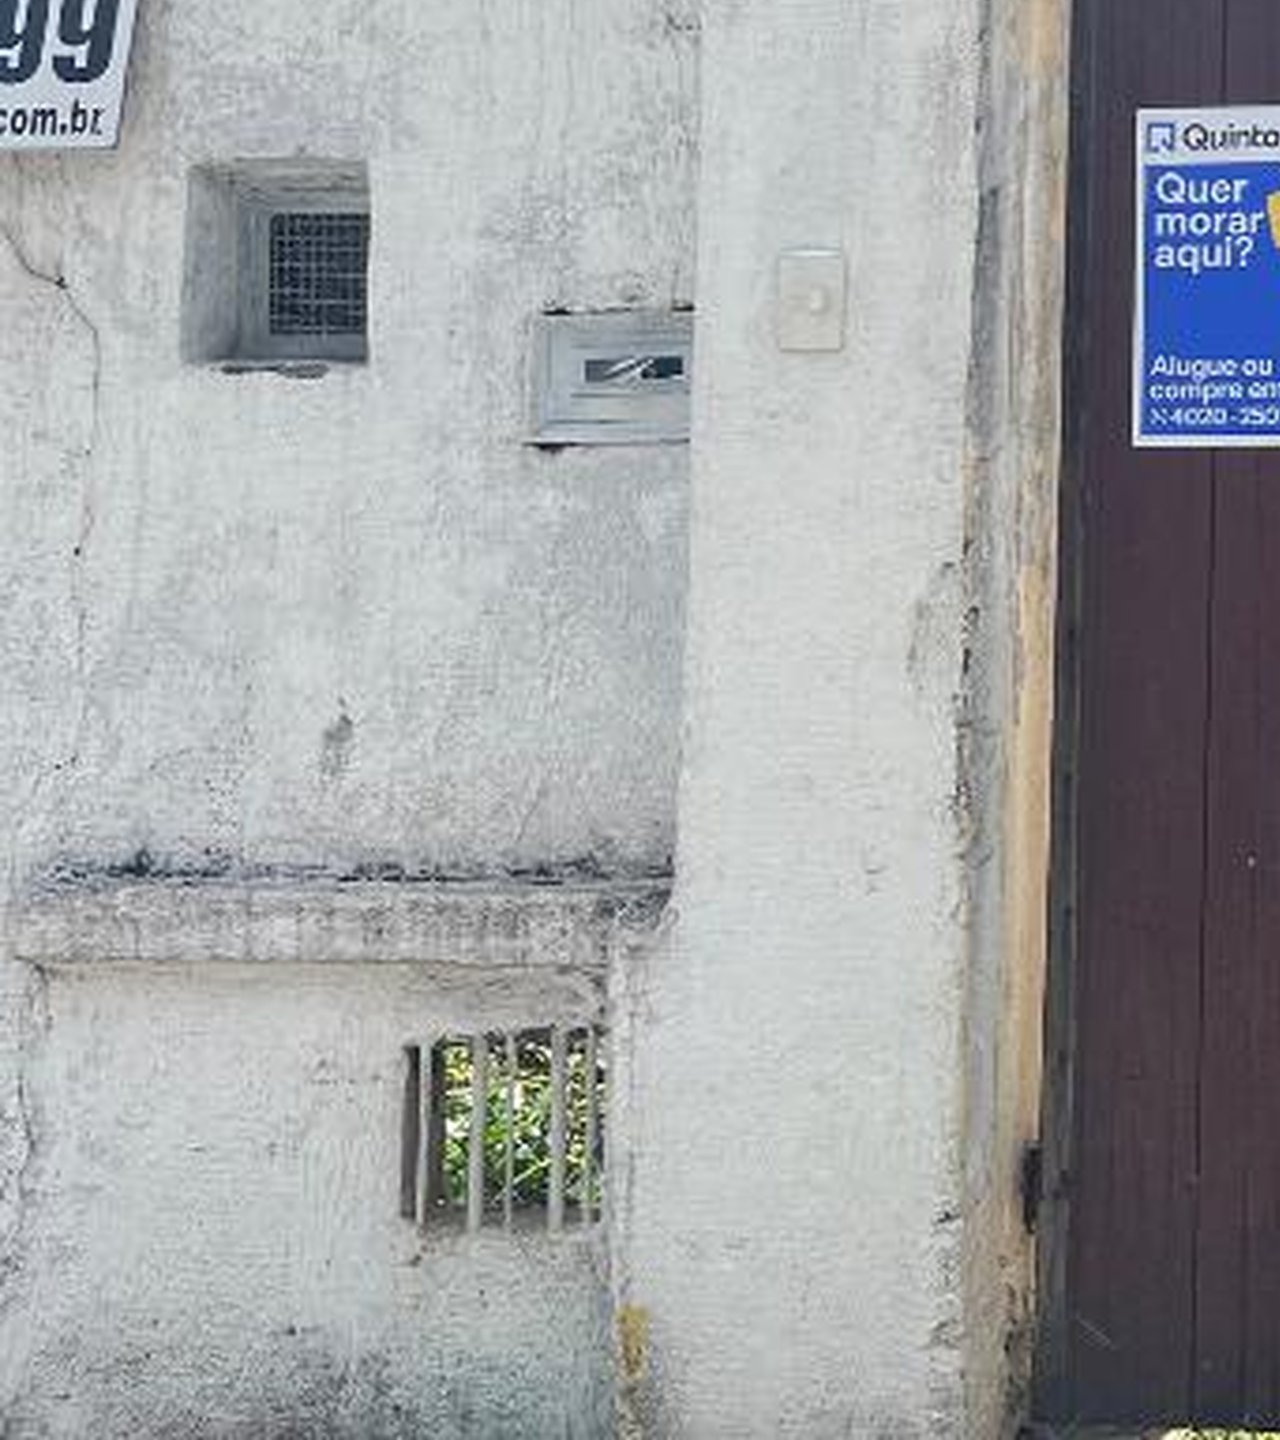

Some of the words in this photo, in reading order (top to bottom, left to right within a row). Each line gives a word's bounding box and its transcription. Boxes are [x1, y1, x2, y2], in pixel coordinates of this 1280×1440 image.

[1155, 171, 1248, 204] Quer
[1155, 212, 1265, 235] morar
[1153, 236, 1253, 275] aqui?
[1150, 355, 1238, 382] Alugue
[1241, 358, 1273, 376] ou
[1150, 381, 1244, 405] compre
